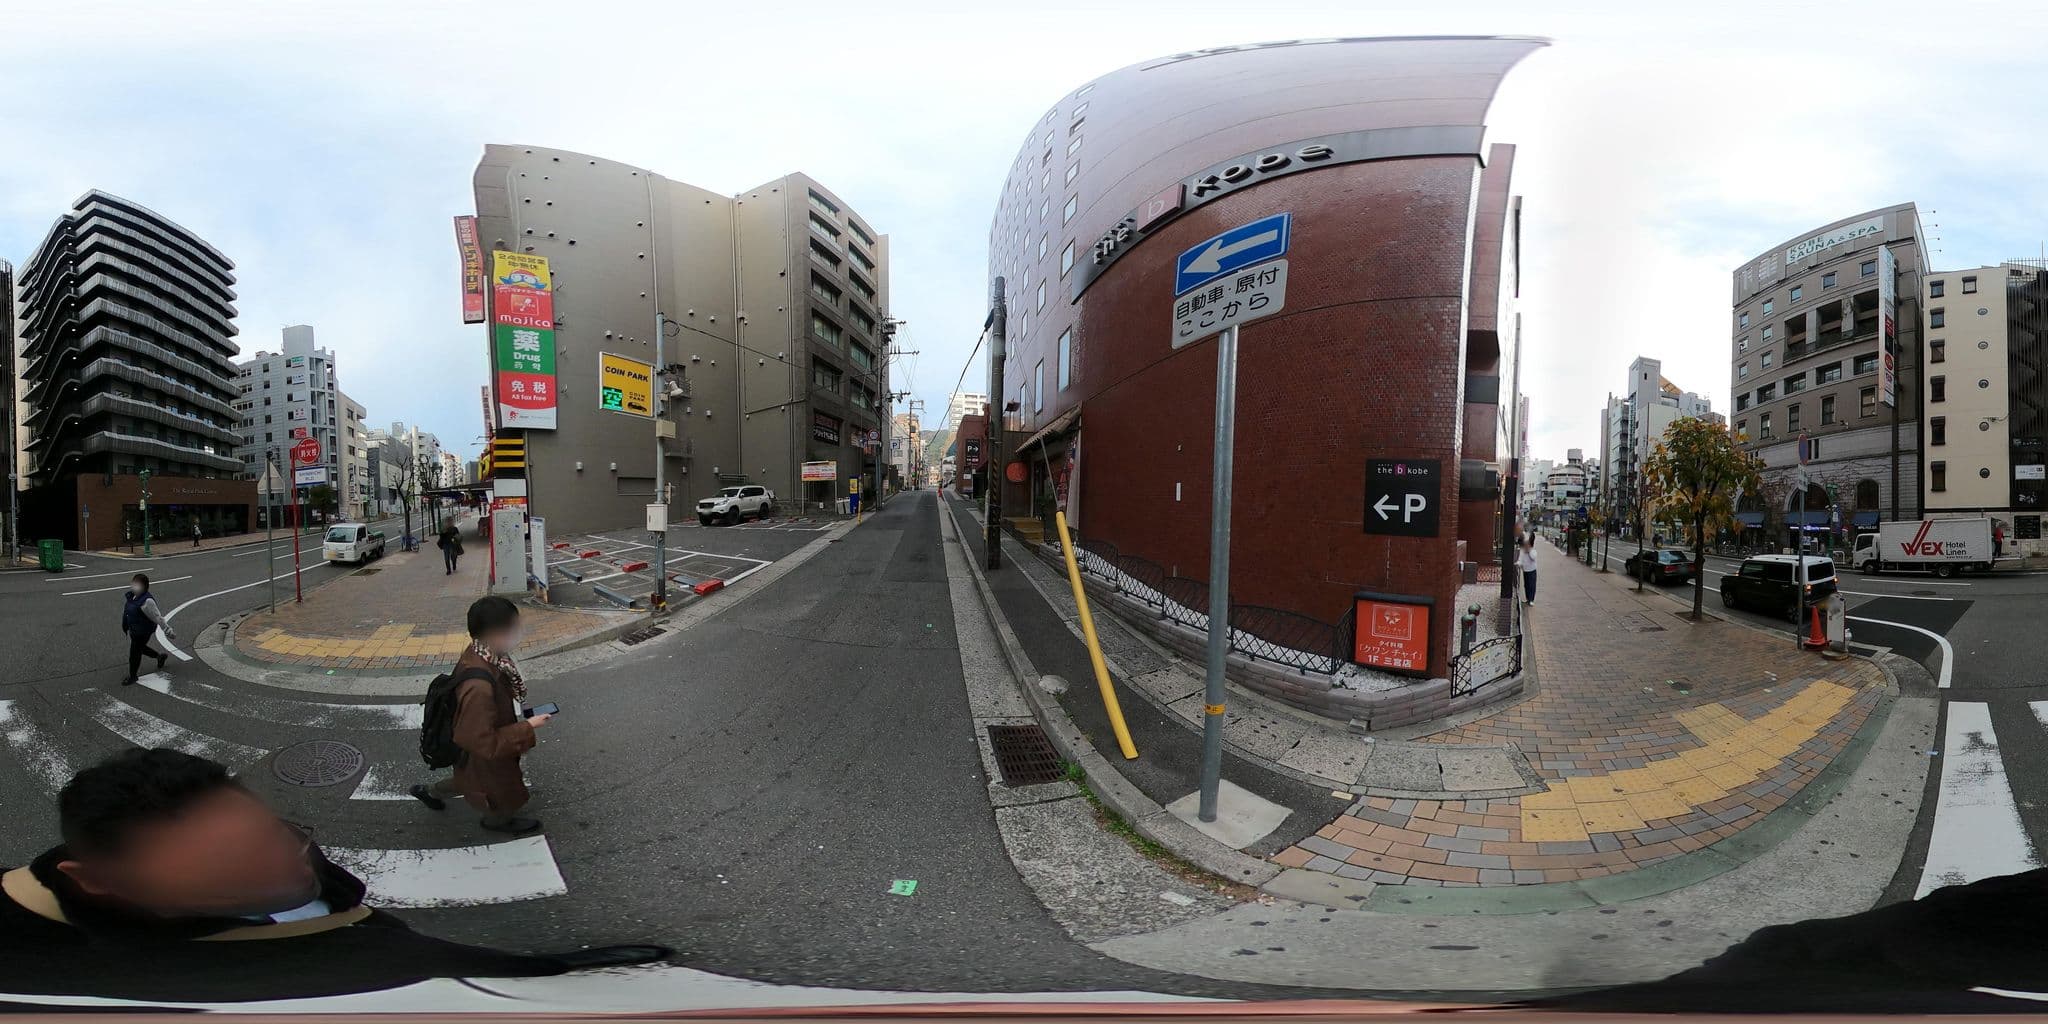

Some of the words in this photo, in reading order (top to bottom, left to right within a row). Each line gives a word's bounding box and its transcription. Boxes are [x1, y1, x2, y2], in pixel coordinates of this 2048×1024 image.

[1093, 226, 1129, 264] the
[1192, 144, 1335, 198] kobe
[1790, 239, 1835, 261] SAUNA
[1849, 225, 1878, 239] SPA
[1790, 237, 1822, 253] KOBE
[1177, 267, 1280, 320] 自動車・原付
[500, 314, 551, 328] majica
[1180, 293, 1270, 337] ここから
[513, 329, 540, 352] 薬
[513, 352, 541, 363] Drug
[605, 366, 626, 377] COIN
[627, 371, 649, 383] PARK
[1377, 467, 1393, 475] the
[1407, 467, 1429, 475] kobe
[1404, 493, 1427, 523] P
[1901, 520, 1945, 556] WEX
[1946, 541, 1966, 549] Hotel
[1368, 654, 1380, 664] 1F
